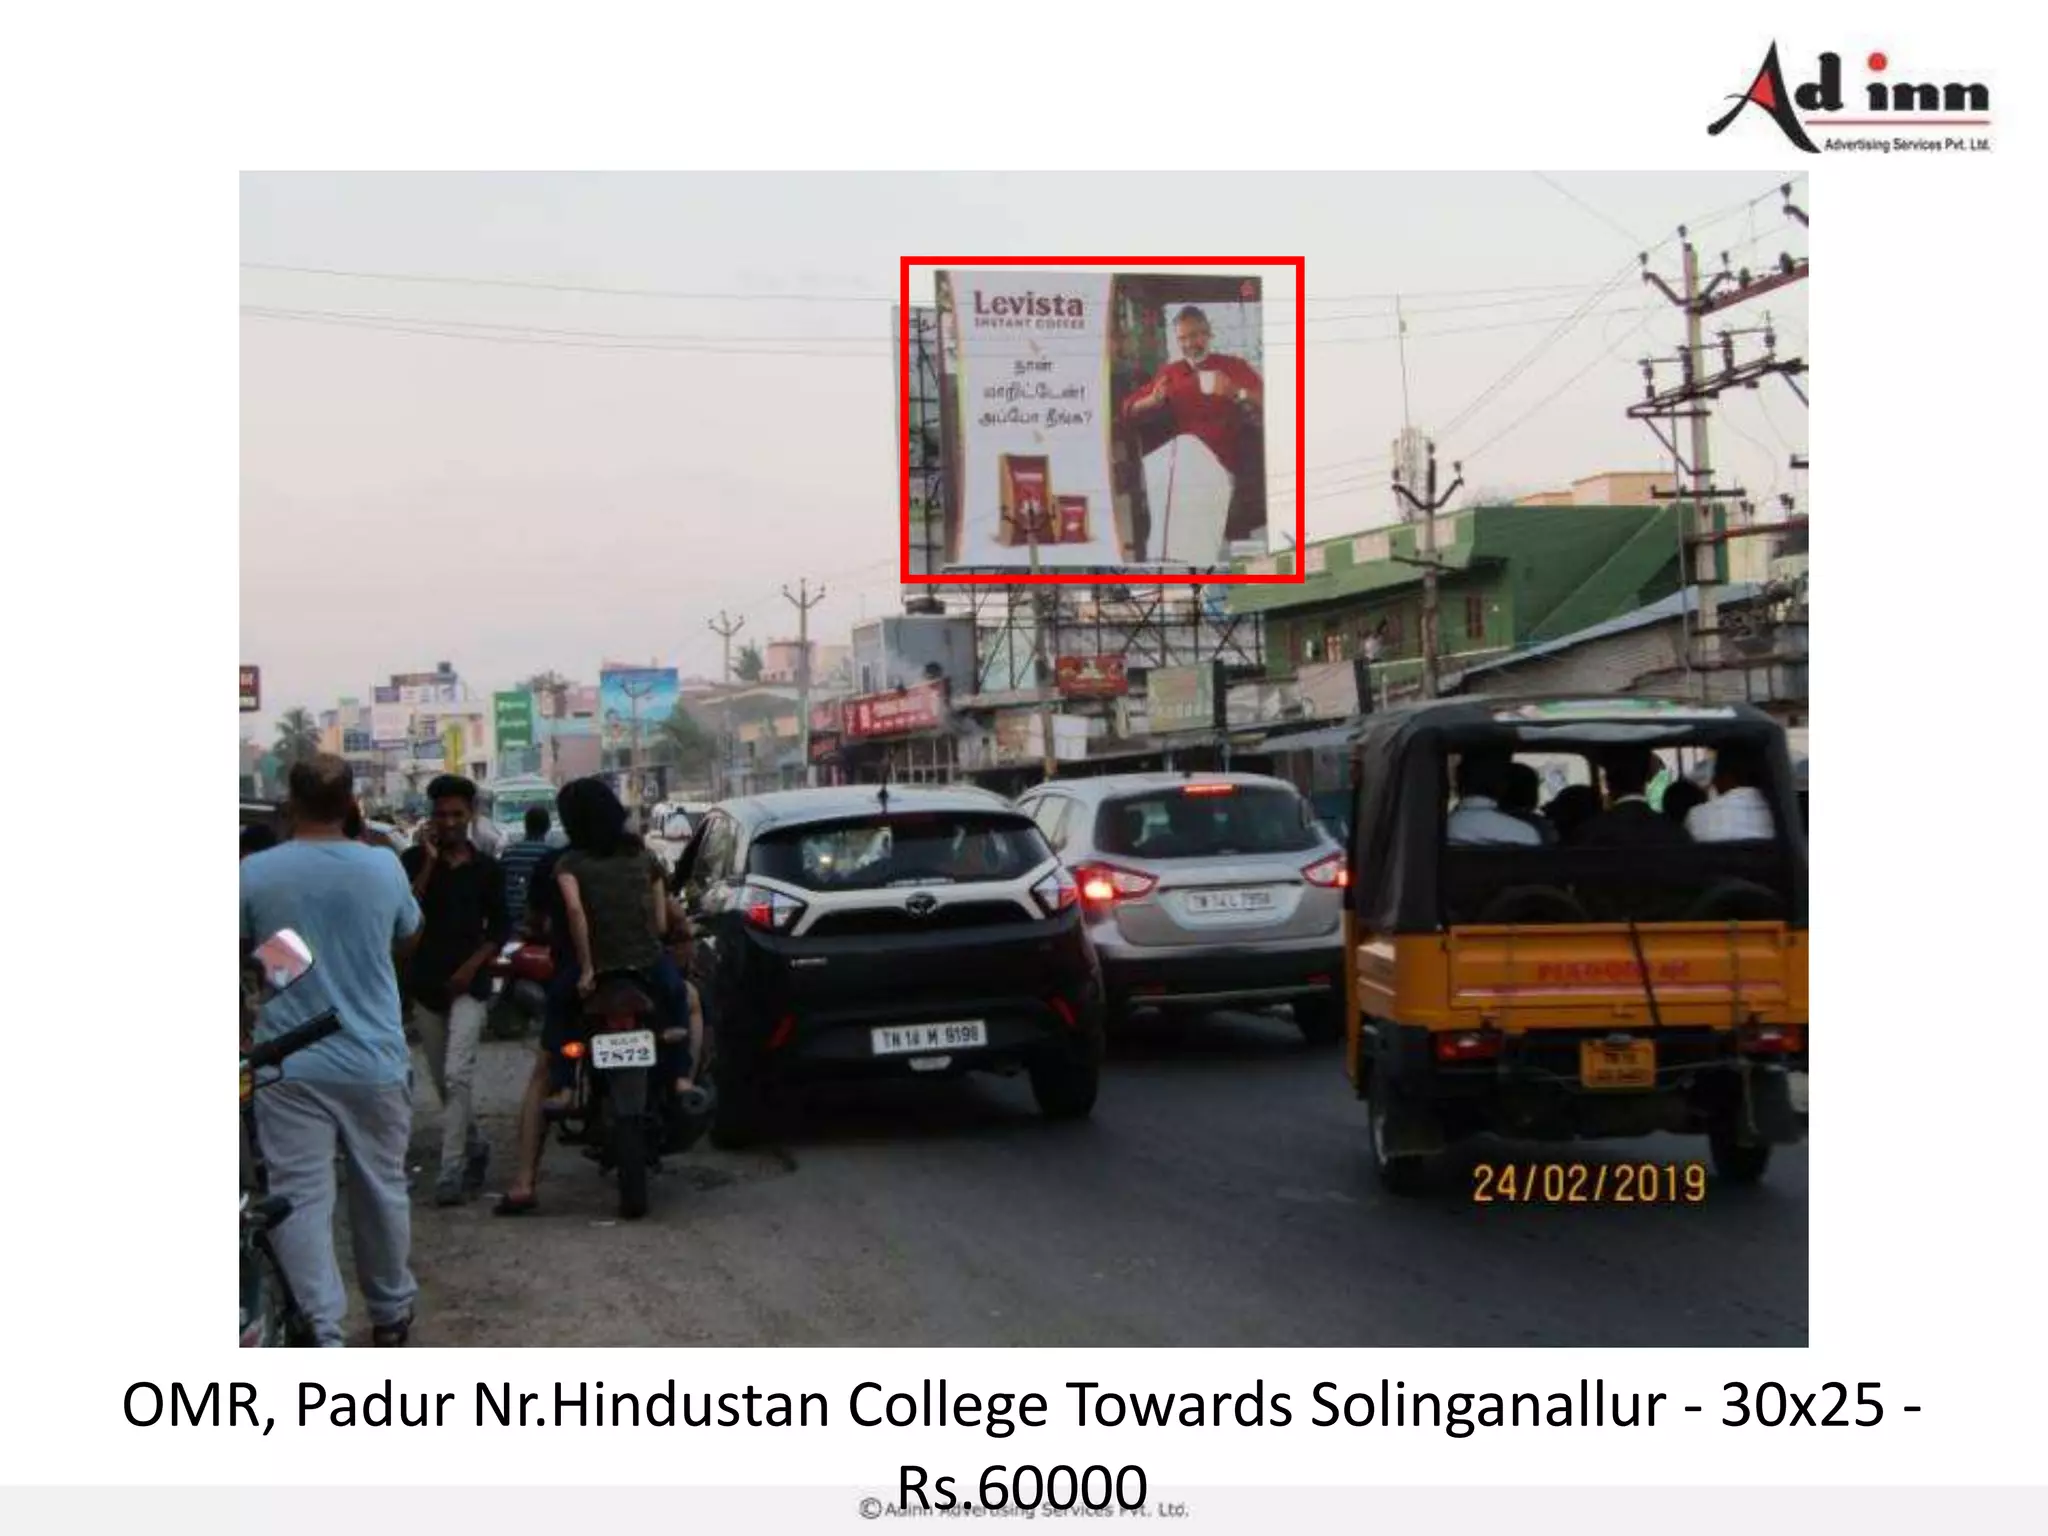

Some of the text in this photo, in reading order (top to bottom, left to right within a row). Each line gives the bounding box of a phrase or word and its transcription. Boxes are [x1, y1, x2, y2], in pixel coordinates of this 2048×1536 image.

[973, 289, 1084, 317] Levista
[974, 317, 1085, 330] INSTANT COFFEE
